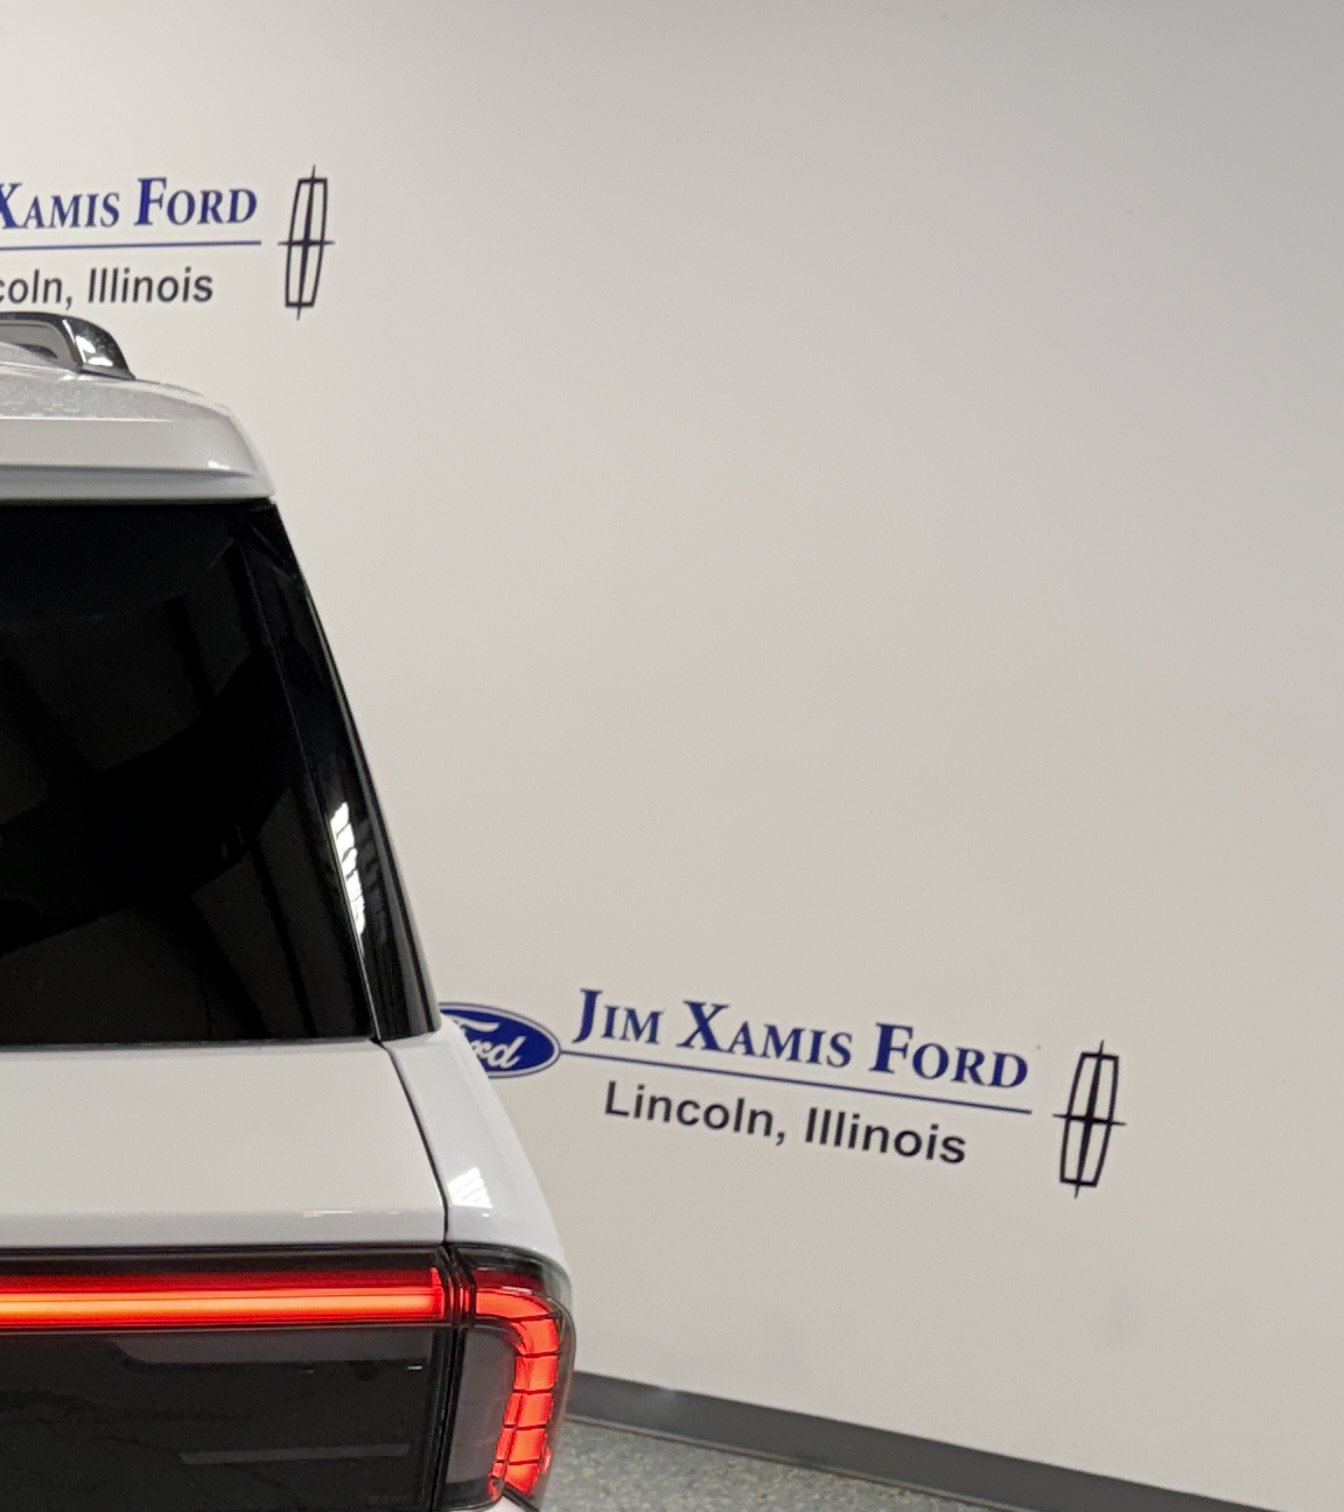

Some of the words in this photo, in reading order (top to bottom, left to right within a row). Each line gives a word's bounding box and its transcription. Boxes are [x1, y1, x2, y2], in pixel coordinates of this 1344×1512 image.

[134, 177, 258, 226] FORD
[88, 266, 213, 303] Illinois
[572, 988, 662, 1044] JIM
[677, 1000, 852, 1069] XAMIS
[868, 1022, 1028, 1089] FORD
[604, 1080, 787, 1146] Lincoln,
[805, 1106, 966, 1164] Illinois
